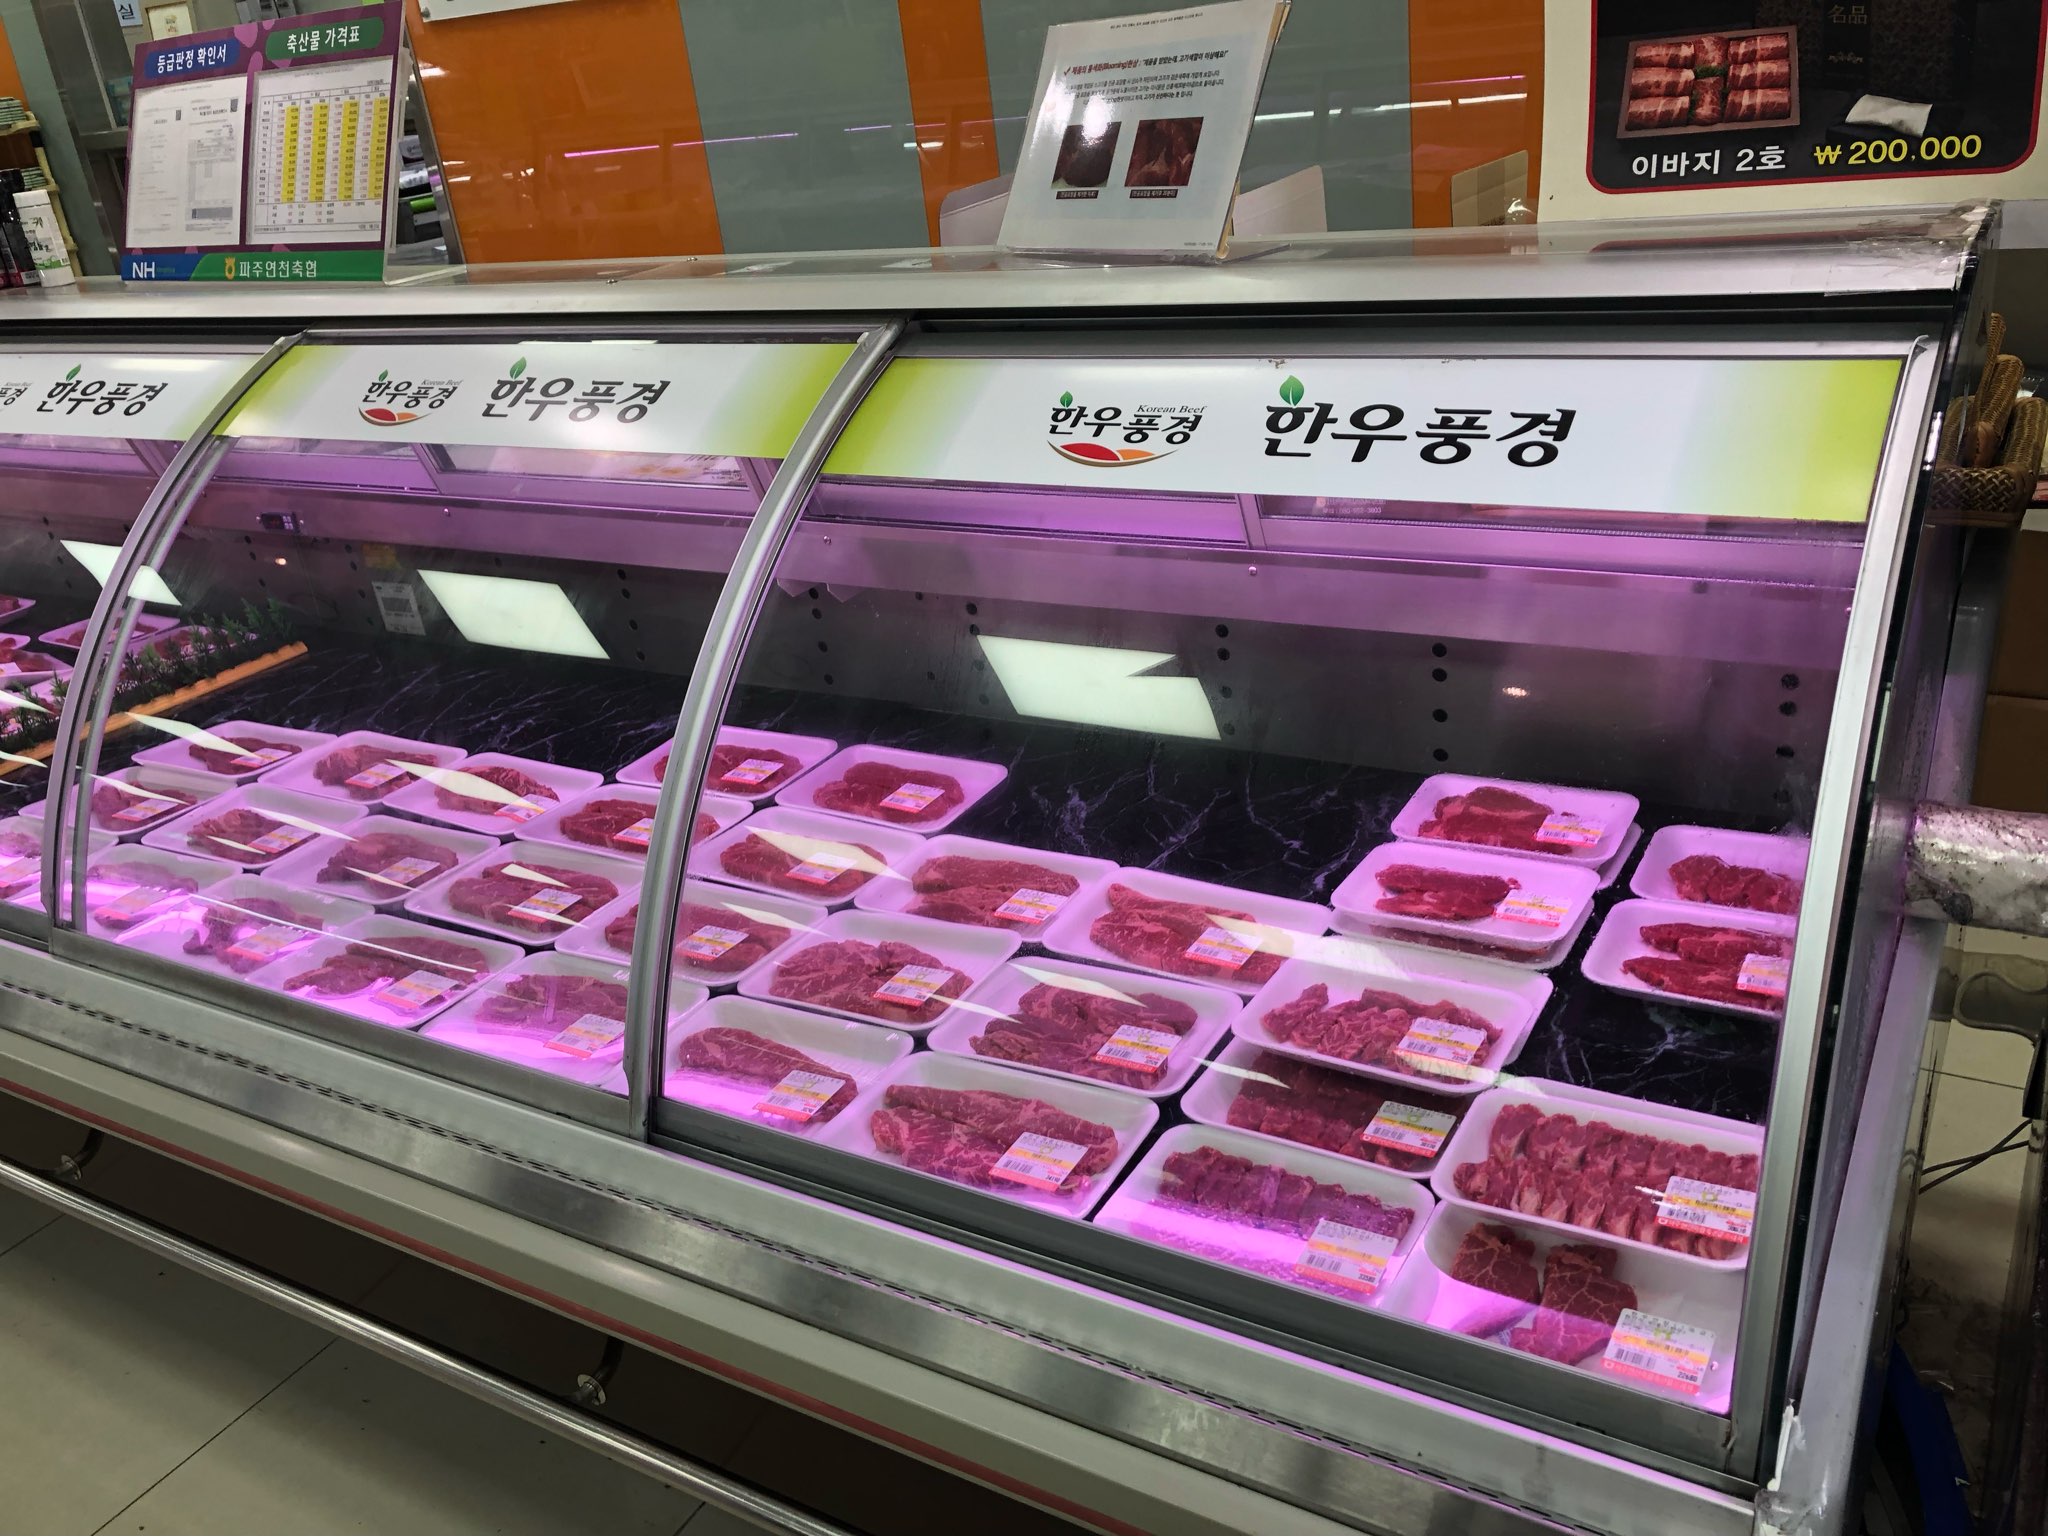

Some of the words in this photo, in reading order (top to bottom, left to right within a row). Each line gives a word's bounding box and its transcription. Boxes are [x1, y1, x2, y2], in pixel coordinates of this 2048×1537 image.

[118, 3, 135, 20] 실
[1828, 5, 1868, 25] 名品
[286, 30, 321, 54] 축산물
[324, 25, 360, 47] 가격표
[157, 49, 194, 74] 등급판정
[197, 43, 227, 64] 확인서
[1632, 149, 1721, 179] 이바지
[1735, 145, 1786, 172] 2호
[132, 261, 156, 278] NH
[239, 260, 317, 278] 파주연천축협
[37, 379, 168, 418] 한우풍경
[362, 380, 458, 409] 한우풍경
[481, 376, 671, 424] 한우풍경
[1137, 404, 1176, 414] Korean
[1178, 405, 1207, 414] Beef
[1048, 404, 1204, 445] 한우풍경
[1263, 402, 1577, 467] 한우풍경
